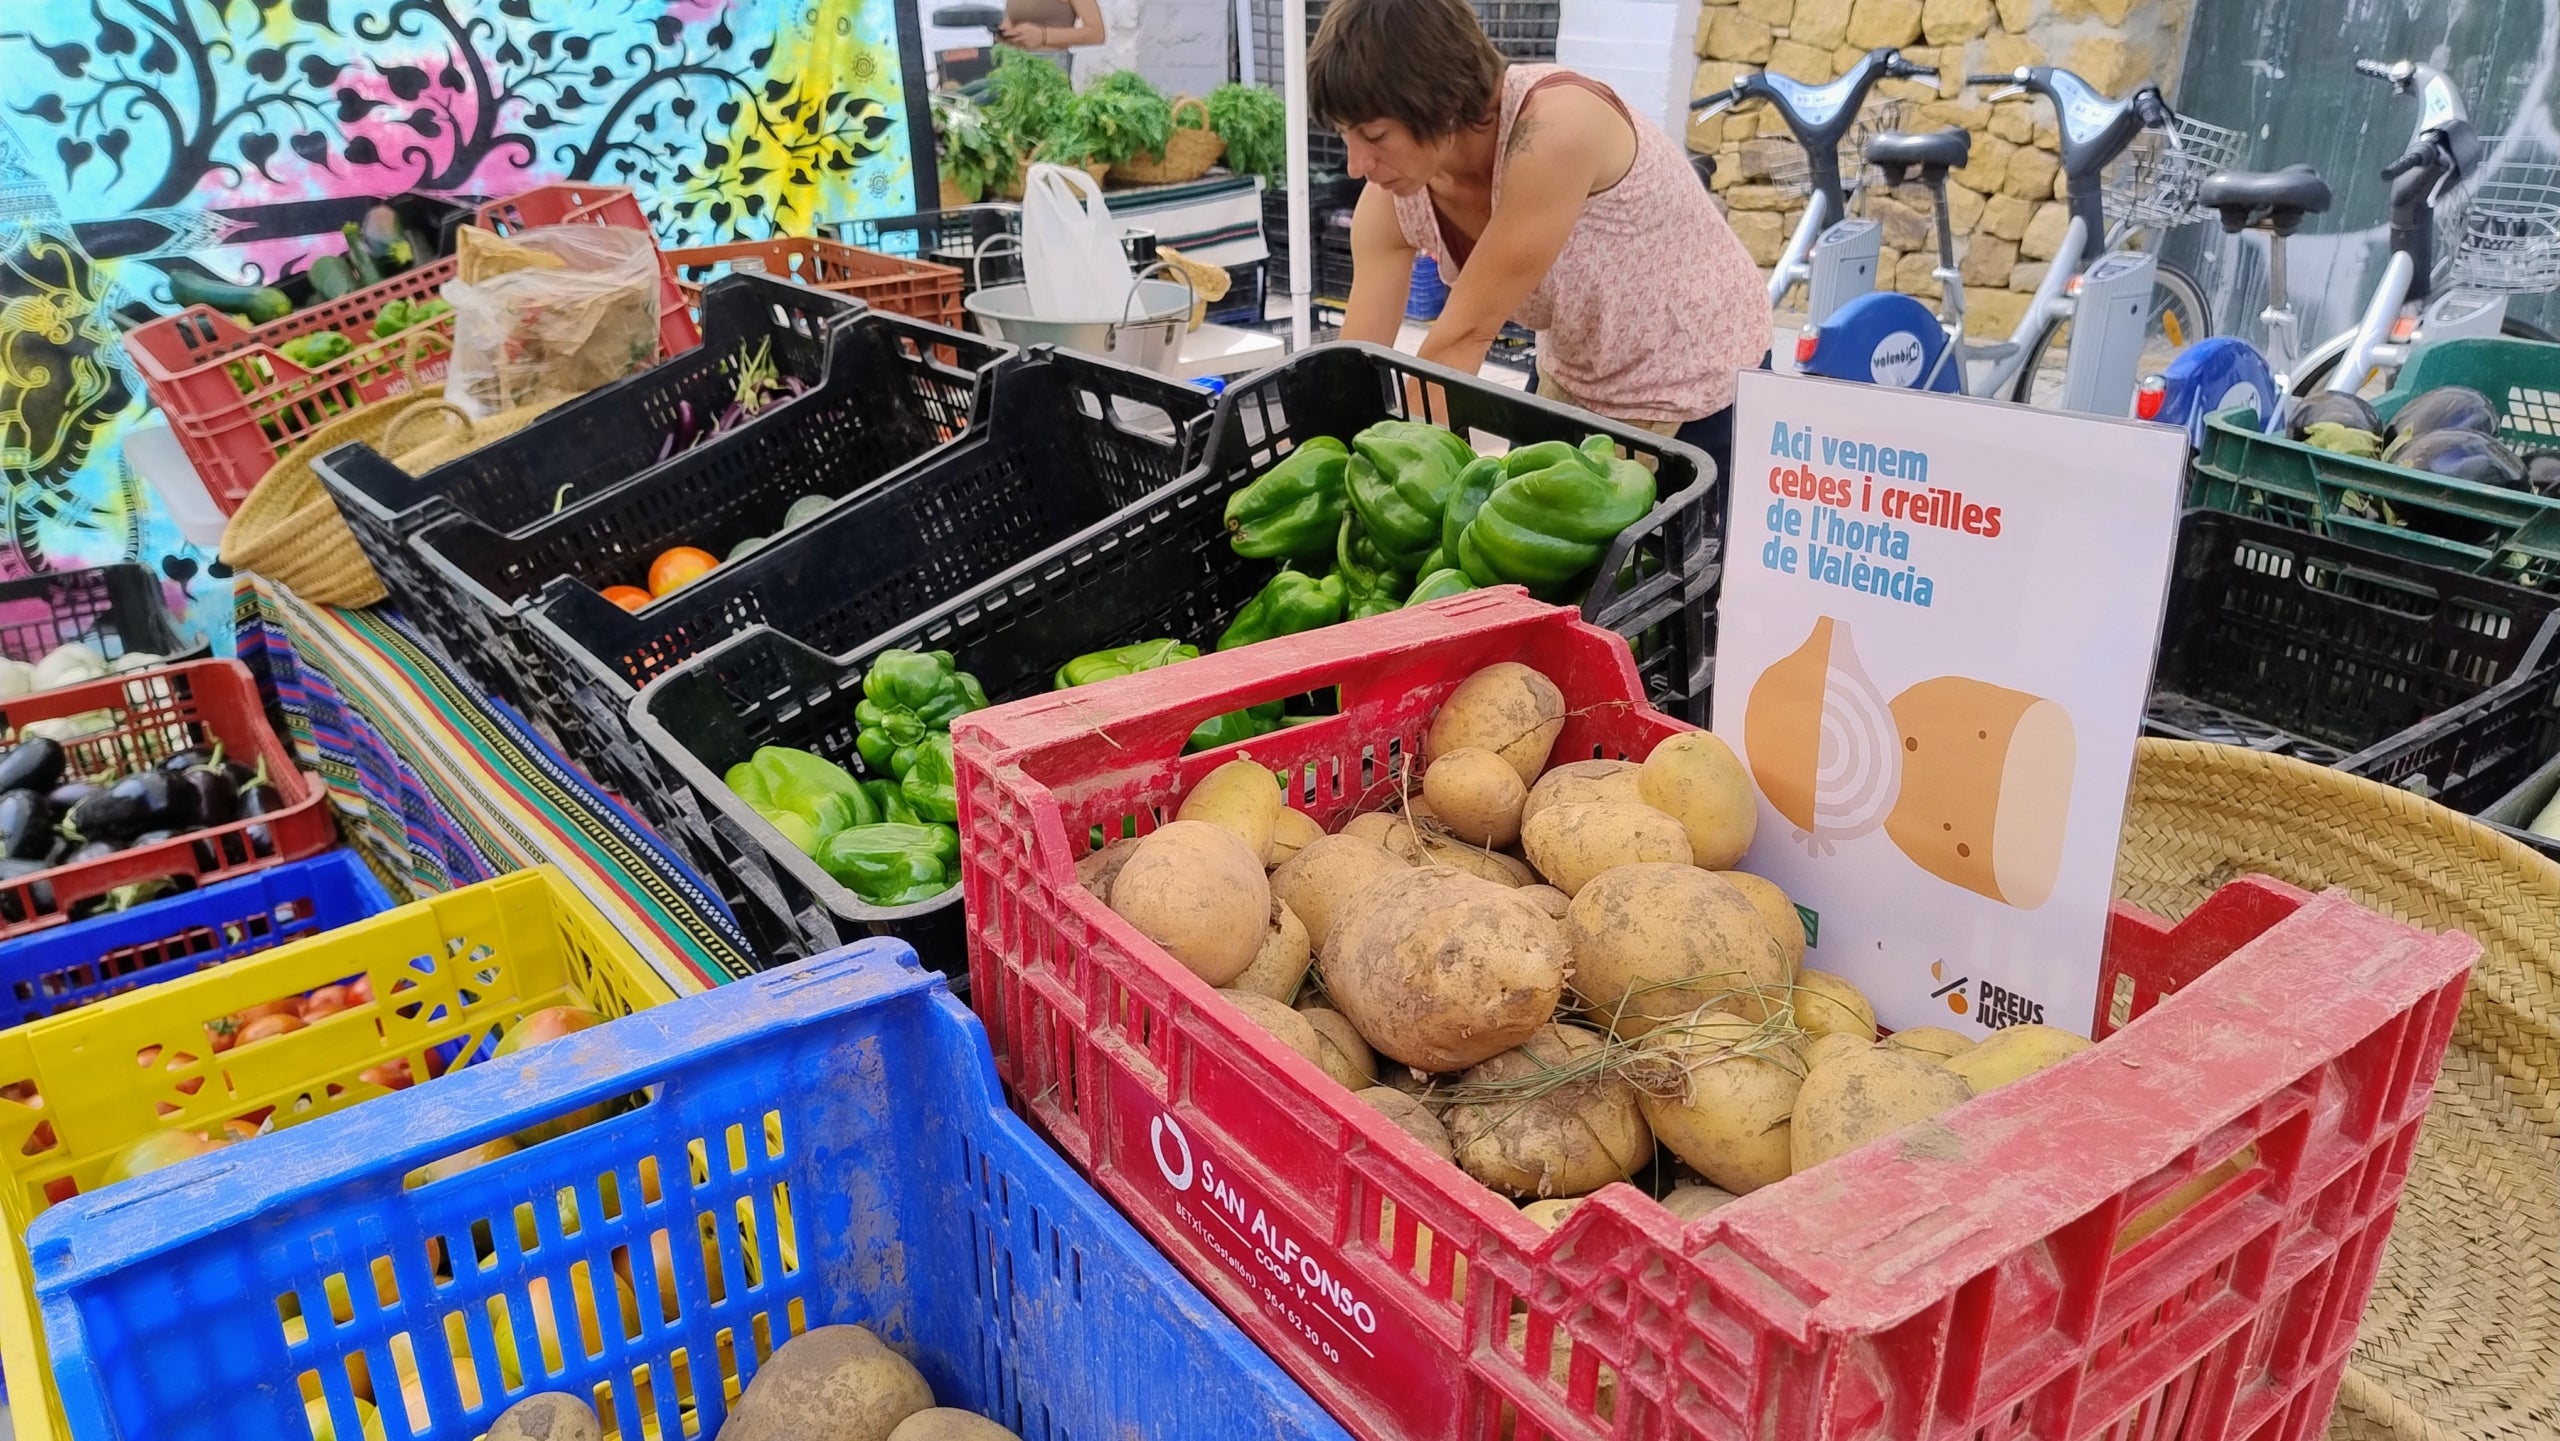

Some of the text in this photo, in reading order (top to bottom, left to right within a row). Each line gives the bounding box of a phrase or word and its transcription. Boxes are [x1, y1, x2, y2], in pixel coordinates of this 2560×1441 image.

[1770, 420, 1928, 483] Aci venem
[1766, 498, 1910, 561] de l'horta
[1769, 465, 2002, 538] cebes i creïlles
[1762, 535, 1934, 608] de València
[1975, 1002, 2029, 1031] JUST
[1980, 980, 2044, 1025] PREUS
[1201, 1160, 1376, 1334] SAN ALFONSO
[1264, 1287, 1286, 1315] 964
[1287, 1310, 1302, 1331] 62
[1304, 1324, 1319, 1346] 30
[1322, 1341, 1339, 1363] 00
